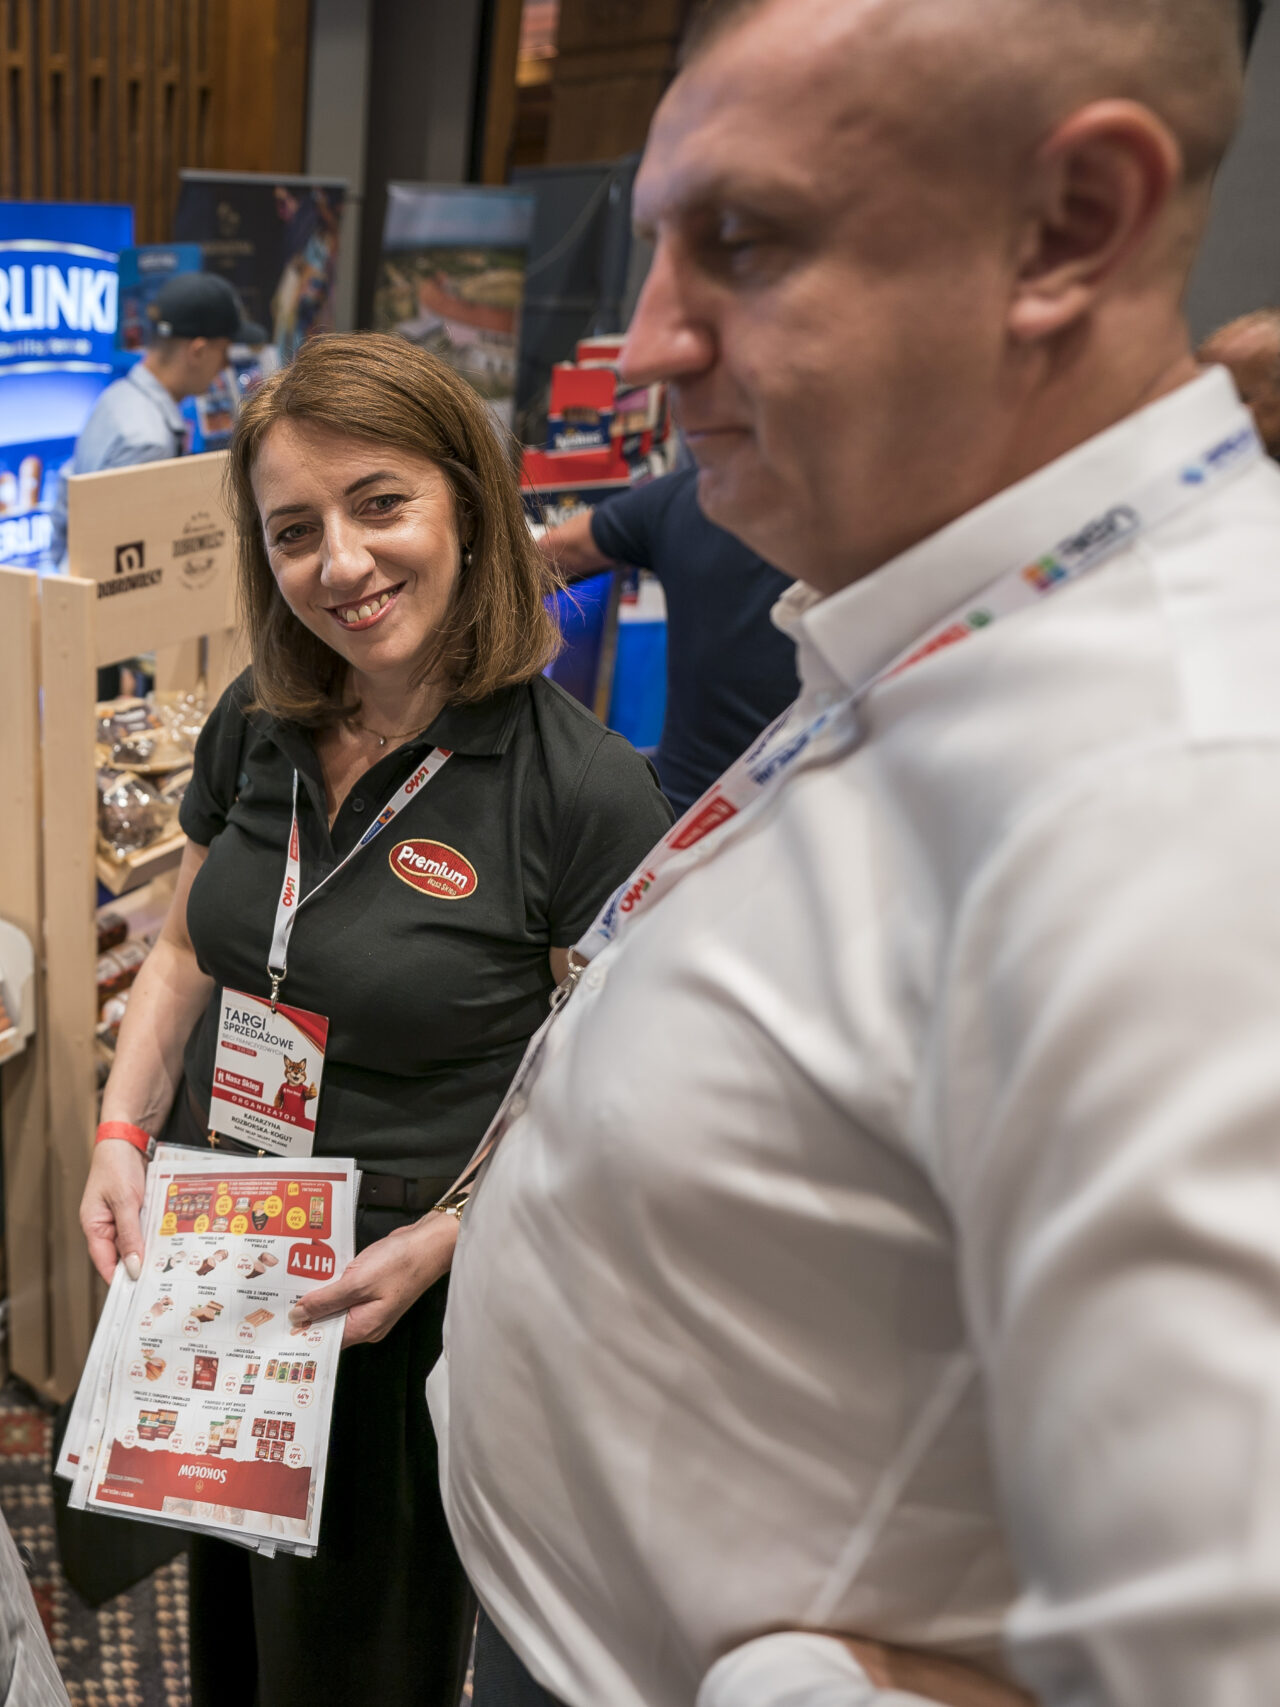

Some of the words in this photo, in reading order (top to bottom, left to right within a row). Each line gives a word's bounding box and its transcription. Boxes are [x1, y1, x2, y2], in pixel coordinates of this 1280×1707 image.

[397, 845, 468, 889] Premium
[225, 1007, 266, 1031] TARGI
[223, 1021, 294, 1051] SPRZEDAŻOWE
[225, 1073, 241, 1085] Nasz
[241, 1079, 260, 1092] Sklep
[231, 1095, 296, 1122] ORGANIZATOR
[244, 1113, 281, 1130] KATARZYNA
[290, 1251, 333, 1274] HITY
